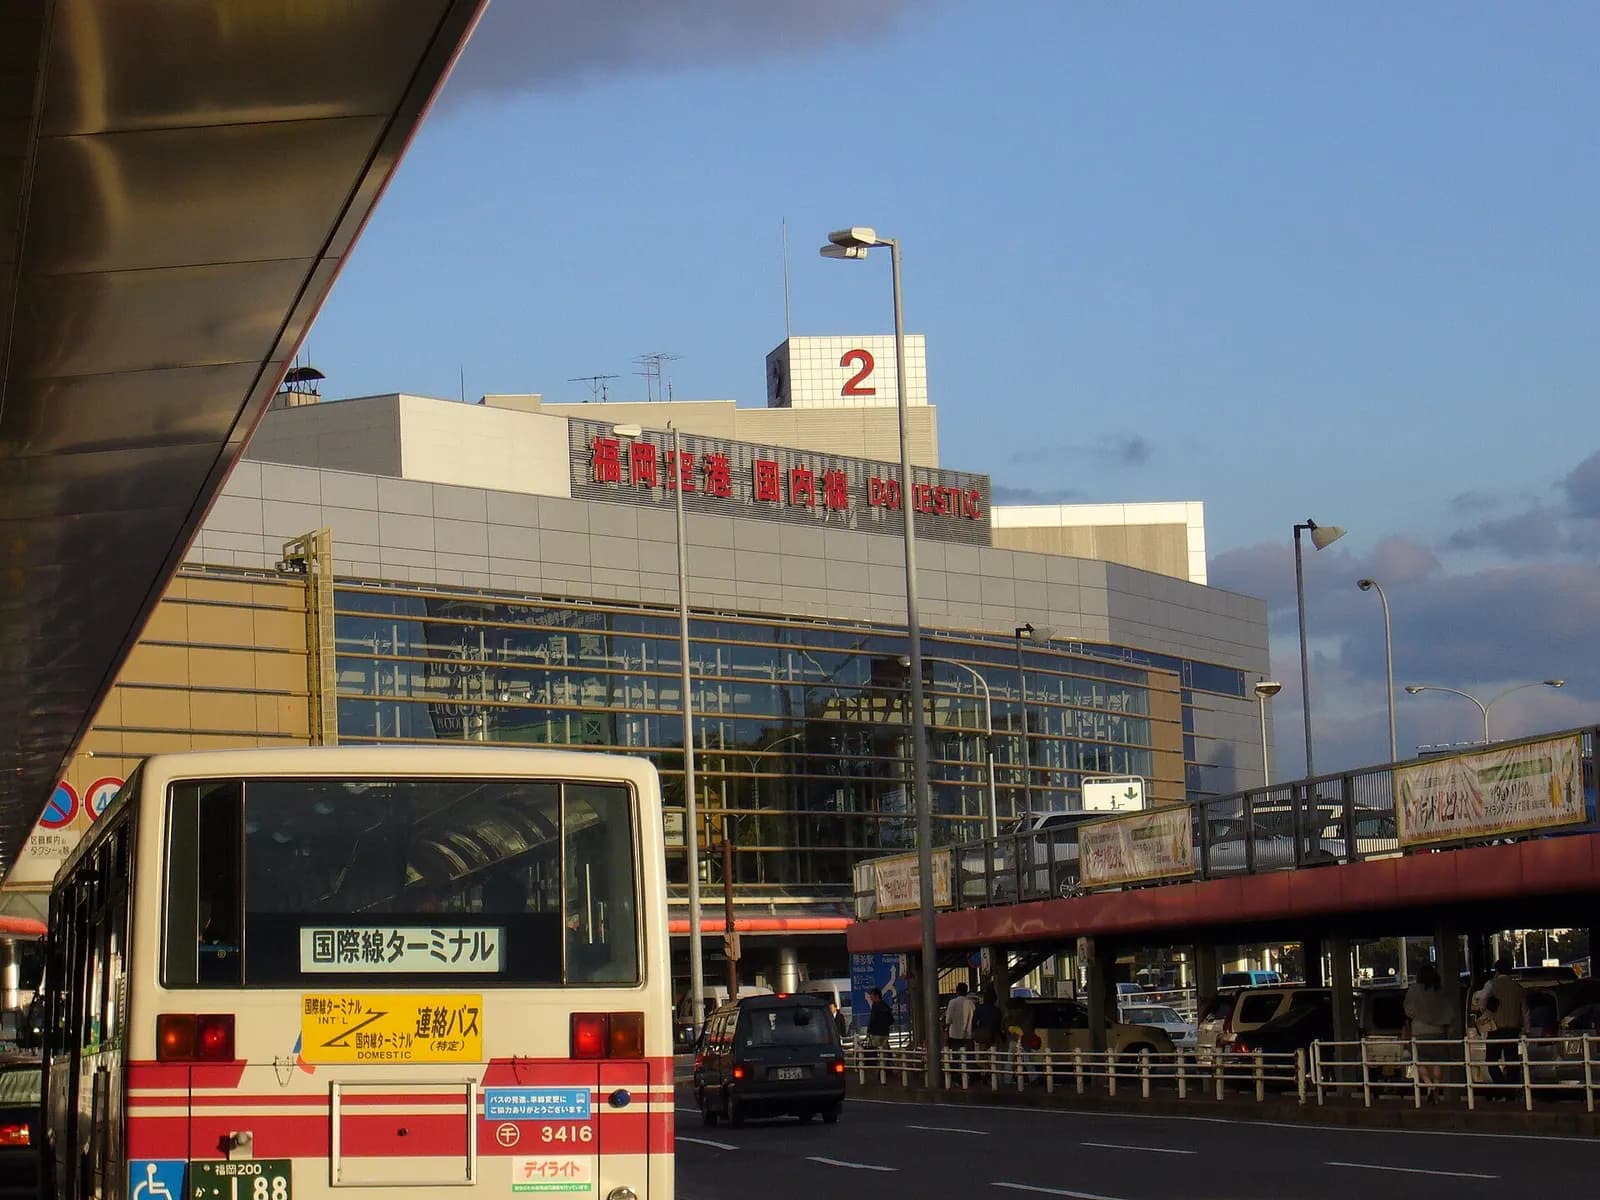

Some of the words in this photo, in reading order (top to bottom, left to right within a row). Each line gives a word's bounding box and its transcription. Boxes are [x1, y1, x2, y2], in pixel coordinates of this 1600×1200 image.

[840, 349, 876, 396] 2
[591, 436, 732, 498] 福岡空港
[753, 459, 849, 511] 国内線
[312, 929, 495, 964] 国際線ターミナル
[304, 998, 362, 1015] 国際線ターミナル
[414, 1004, 479, 1039] 連絡バス
[355, 1032, 414, 1049] 国内線ターミナル
[357, 1051, 412, 1060] DOMESTIC
[541, 1126, 593, 1143] 3416
[524, 1161, 580, 1178] デイライト
